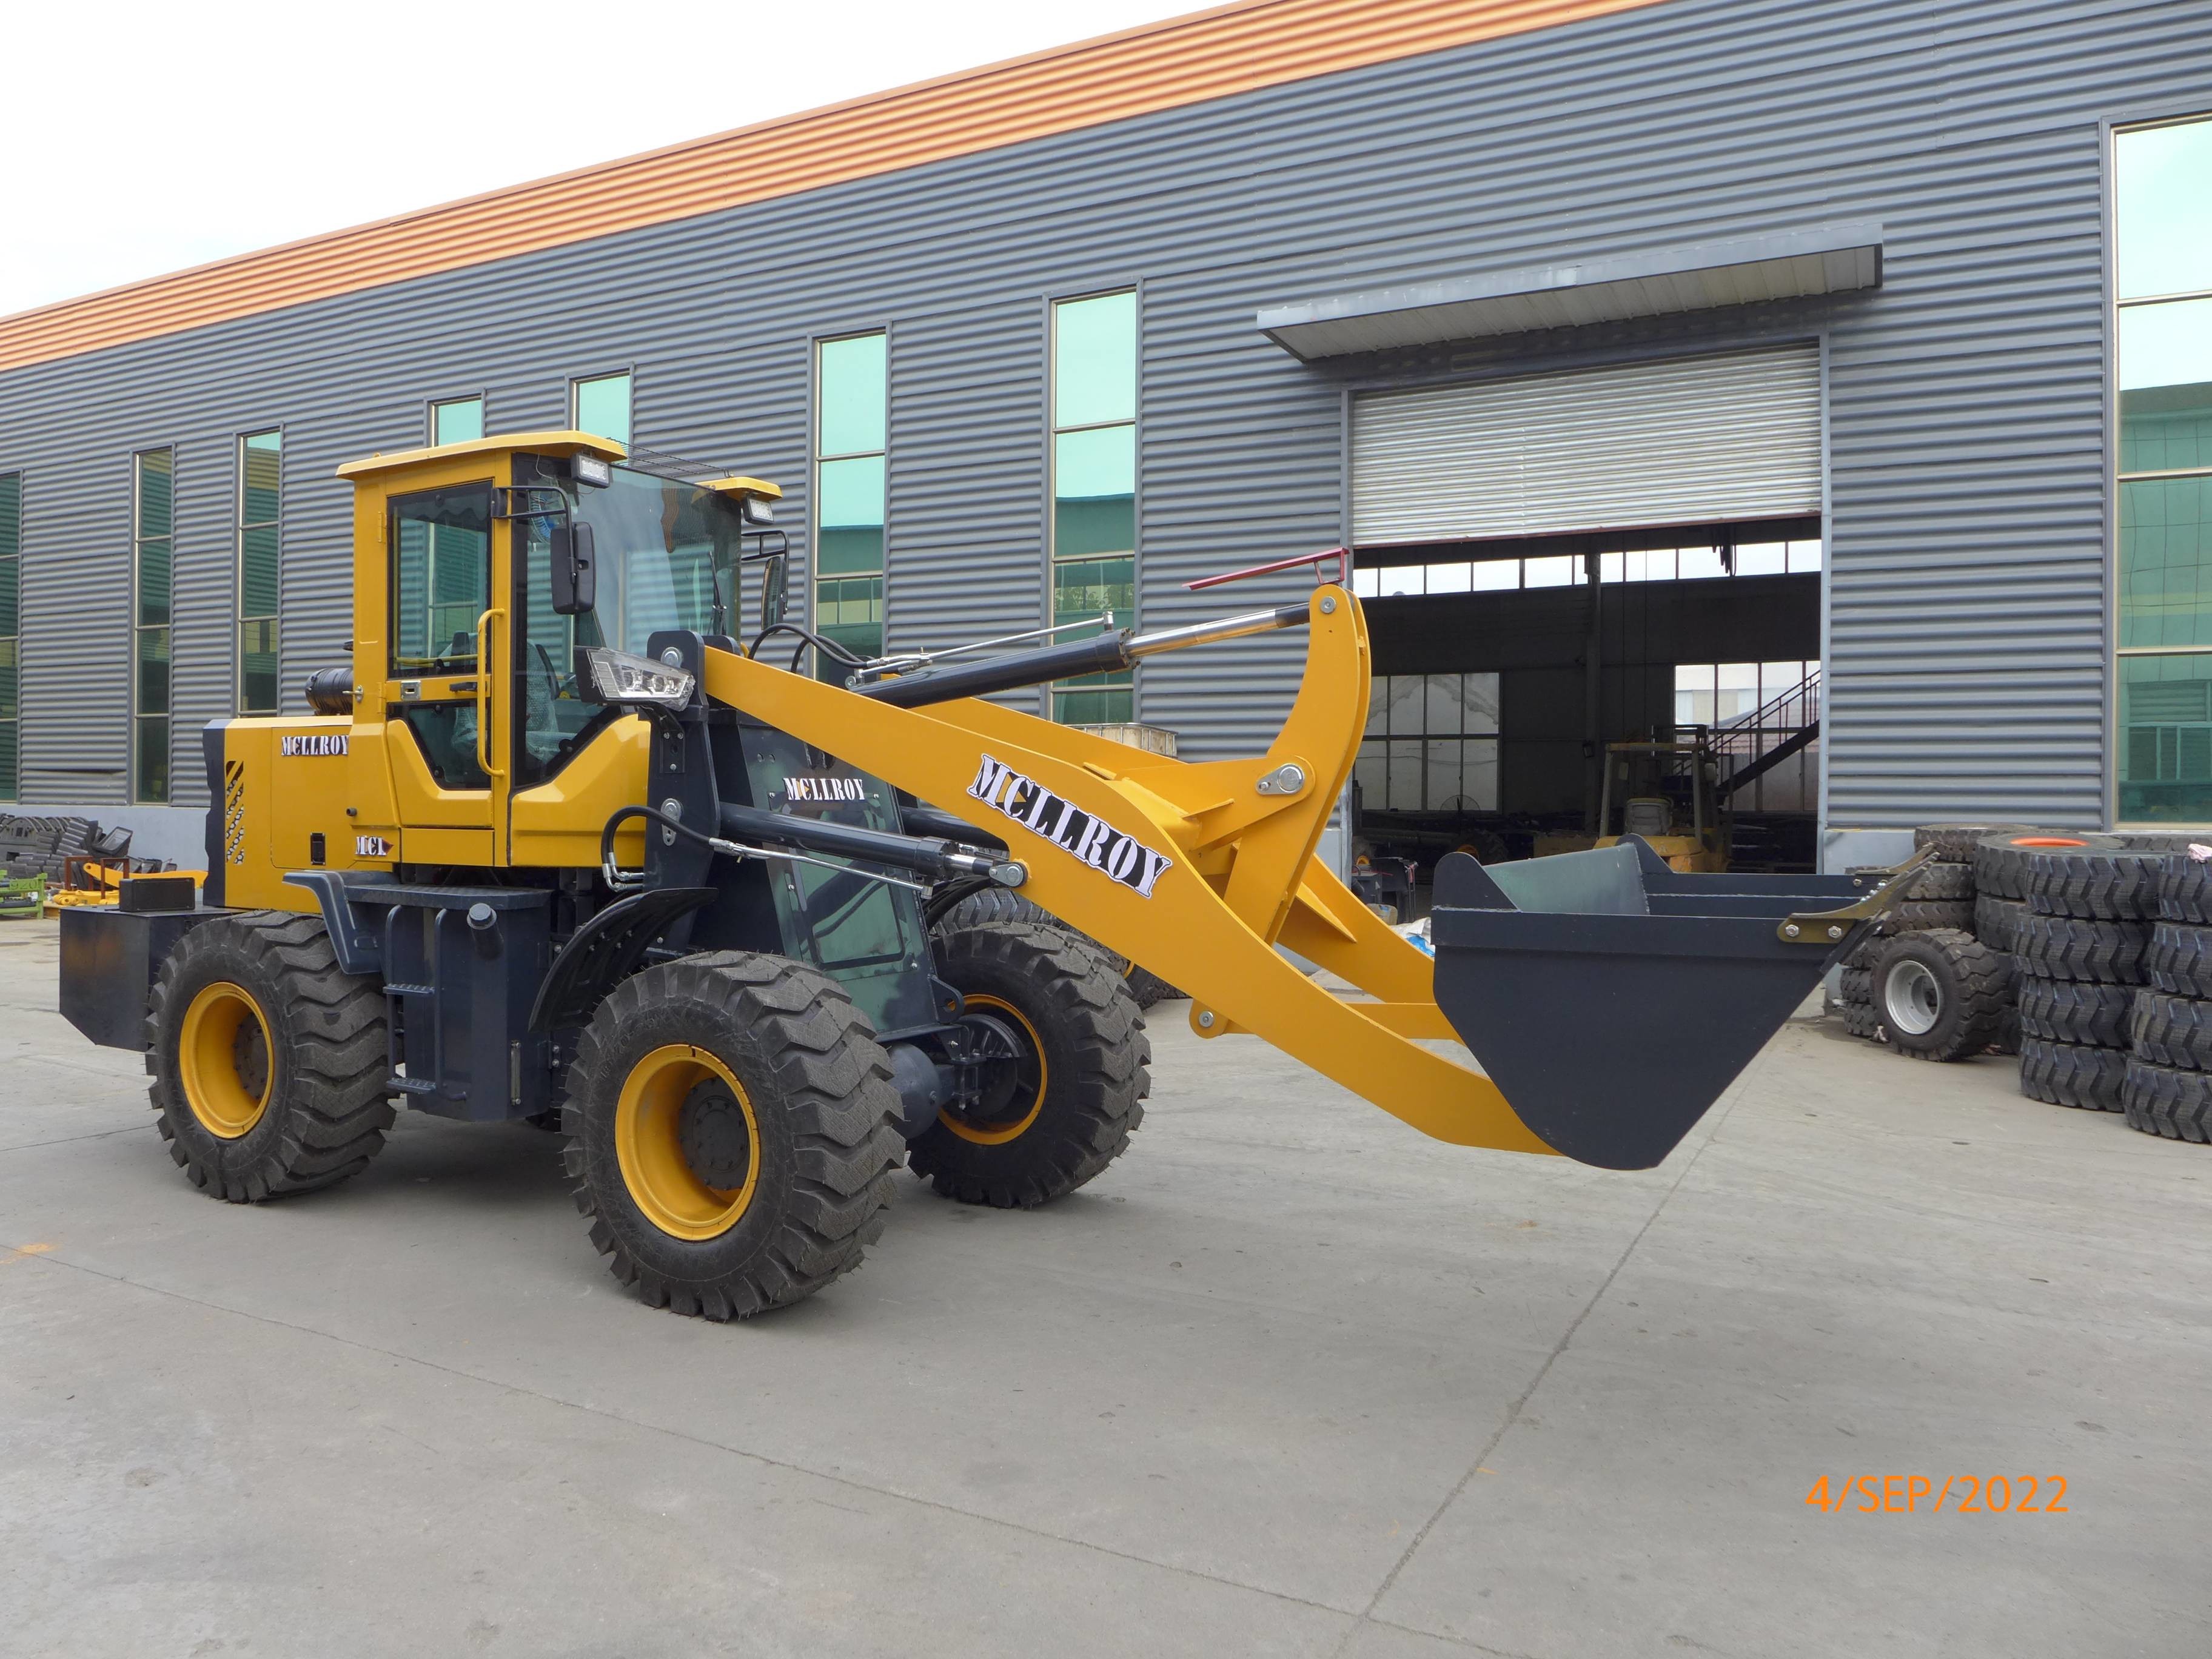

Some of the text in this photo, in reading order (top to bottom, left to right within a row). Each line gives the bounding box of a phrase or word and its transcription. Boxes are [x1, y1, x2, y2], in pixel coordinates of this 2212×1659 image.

[281, 735, 350, 756] MCLLROY
[783, 778, 865, 800] MCLLROY
[967, 754, 1173, 899] MCLLROY
